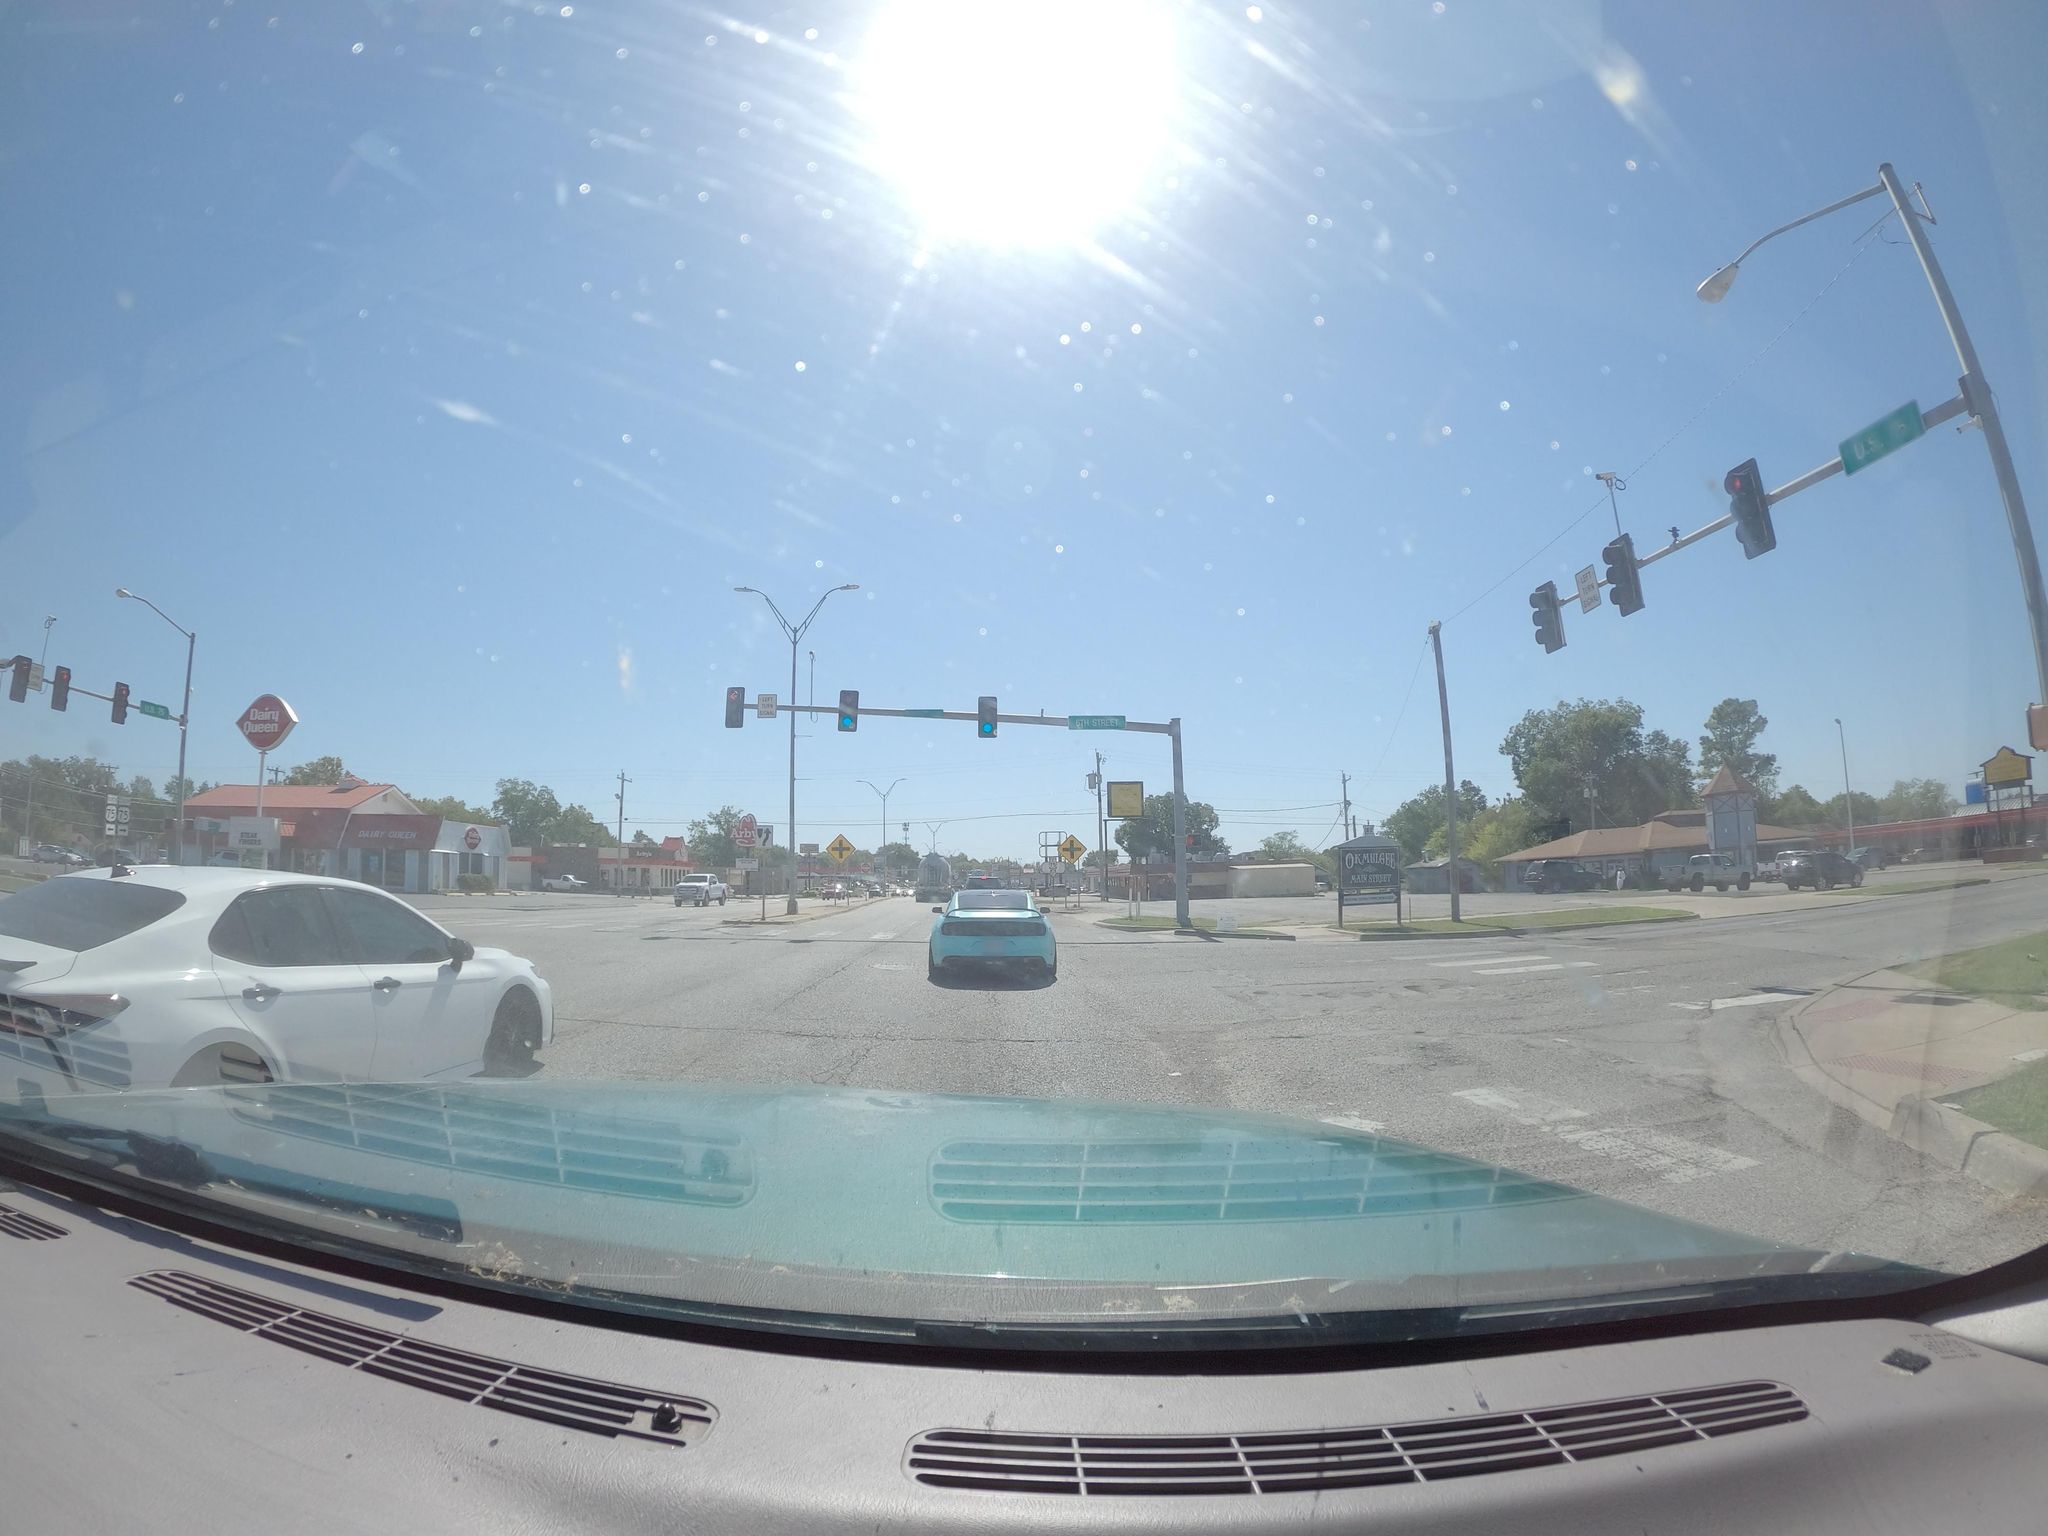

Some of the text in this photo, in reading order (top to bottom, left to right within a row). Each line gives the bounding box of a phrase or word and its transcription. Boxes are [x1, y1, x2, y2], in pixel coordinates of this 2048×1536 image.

[250, 708, 279, 722] Dairy
[1092, 718, 1118, 727] STREET
[243, 722, 278, 735] Queen
[388, 831, 416, 839] QUEEN
[1351, 874, 1368, 884] MAIN
